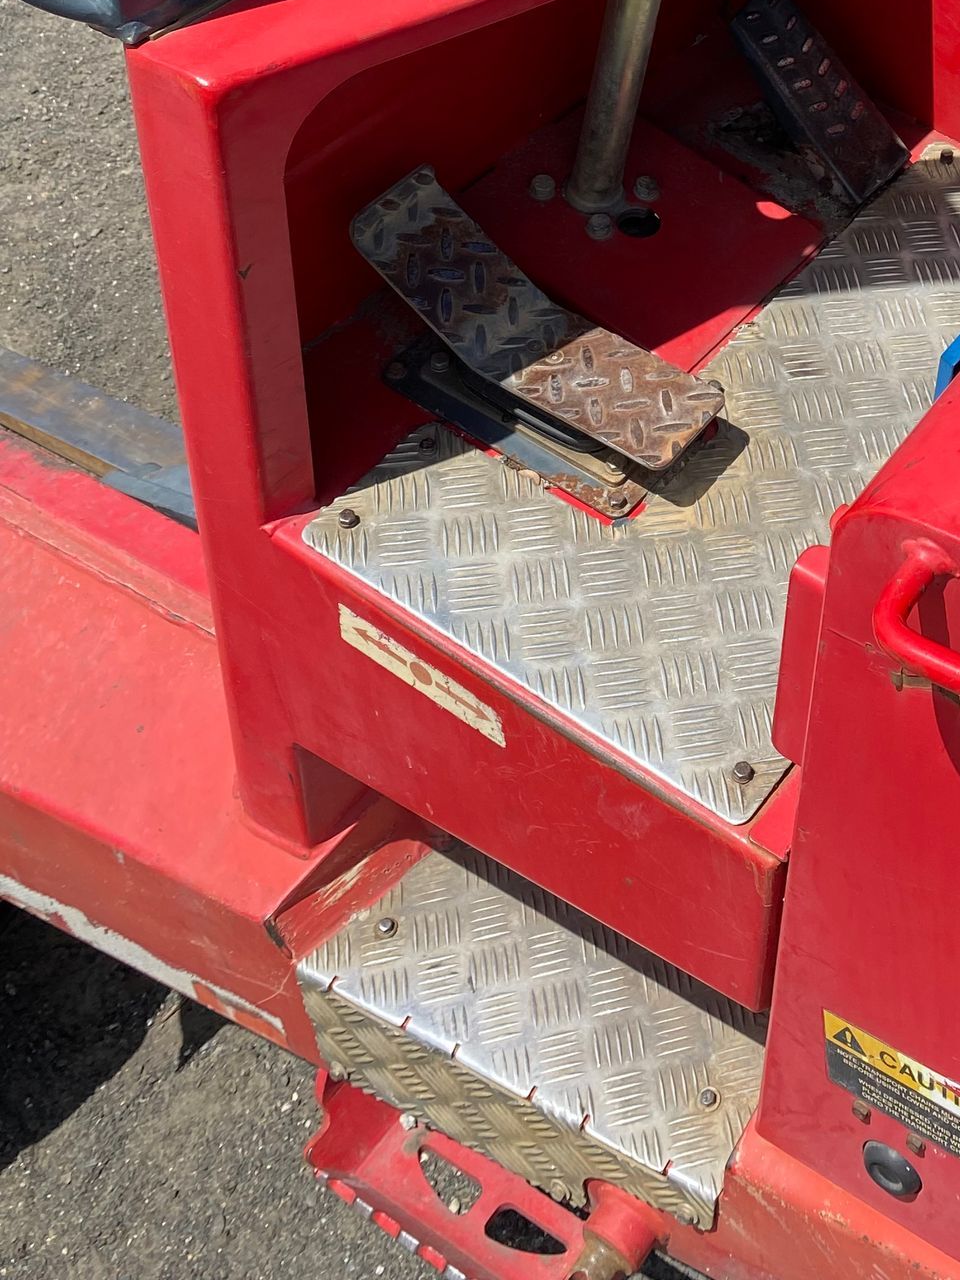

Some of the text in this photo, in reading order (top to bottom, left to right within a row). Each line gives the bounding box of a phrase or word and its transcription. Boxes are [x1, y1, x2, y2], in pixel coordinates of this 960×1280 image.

[842, 1058, 874, 1081] BEFORE
[876, 1078, 900, 1096] USING
[902, 1094, 930, 1113] LOWER
[932, 1112, 950, 1124] AND
[858, 1078, 882, 1096] WHEN
[933, 1122, 951, 1137] THIS
[861, 1063, 908, 1093] TRANSPORT
[910, 1090, 939, 1113] CHAINS
[862, 1086, 892, 1111] PLACES
[894, 1104, 909, 1116] THE
[910, 1113, 948, 1140] FORKLIFT
[861, 1091, 884, 1108] ONTO
[884, 1105, 900, 1118] THE
[900, 1113, 948, 1147] TRANSPORT
